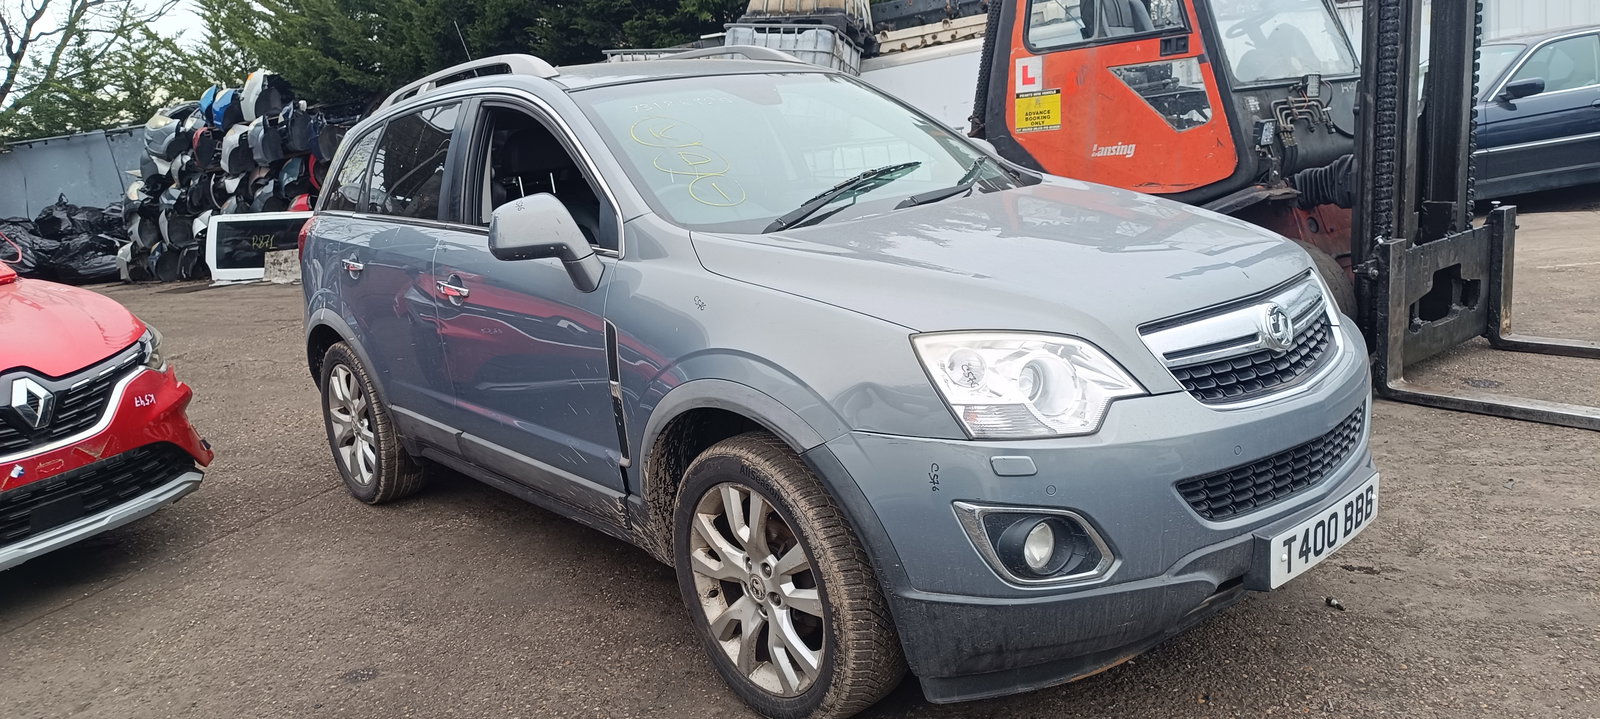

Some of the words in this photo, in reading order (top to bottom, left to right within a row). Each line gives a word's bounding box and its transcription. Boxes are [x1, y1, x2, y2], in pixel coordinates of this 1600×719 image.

[1022, 65, 1036, 86] L
[1024, 109, 1051, 117] ADVANCE
[1091, 142, 1136, 158] Lansing
[928, 462, 940, 492] C576
[1283, 512, 1338, 574] T400
[1343, 485, 1374, 538] BBB
